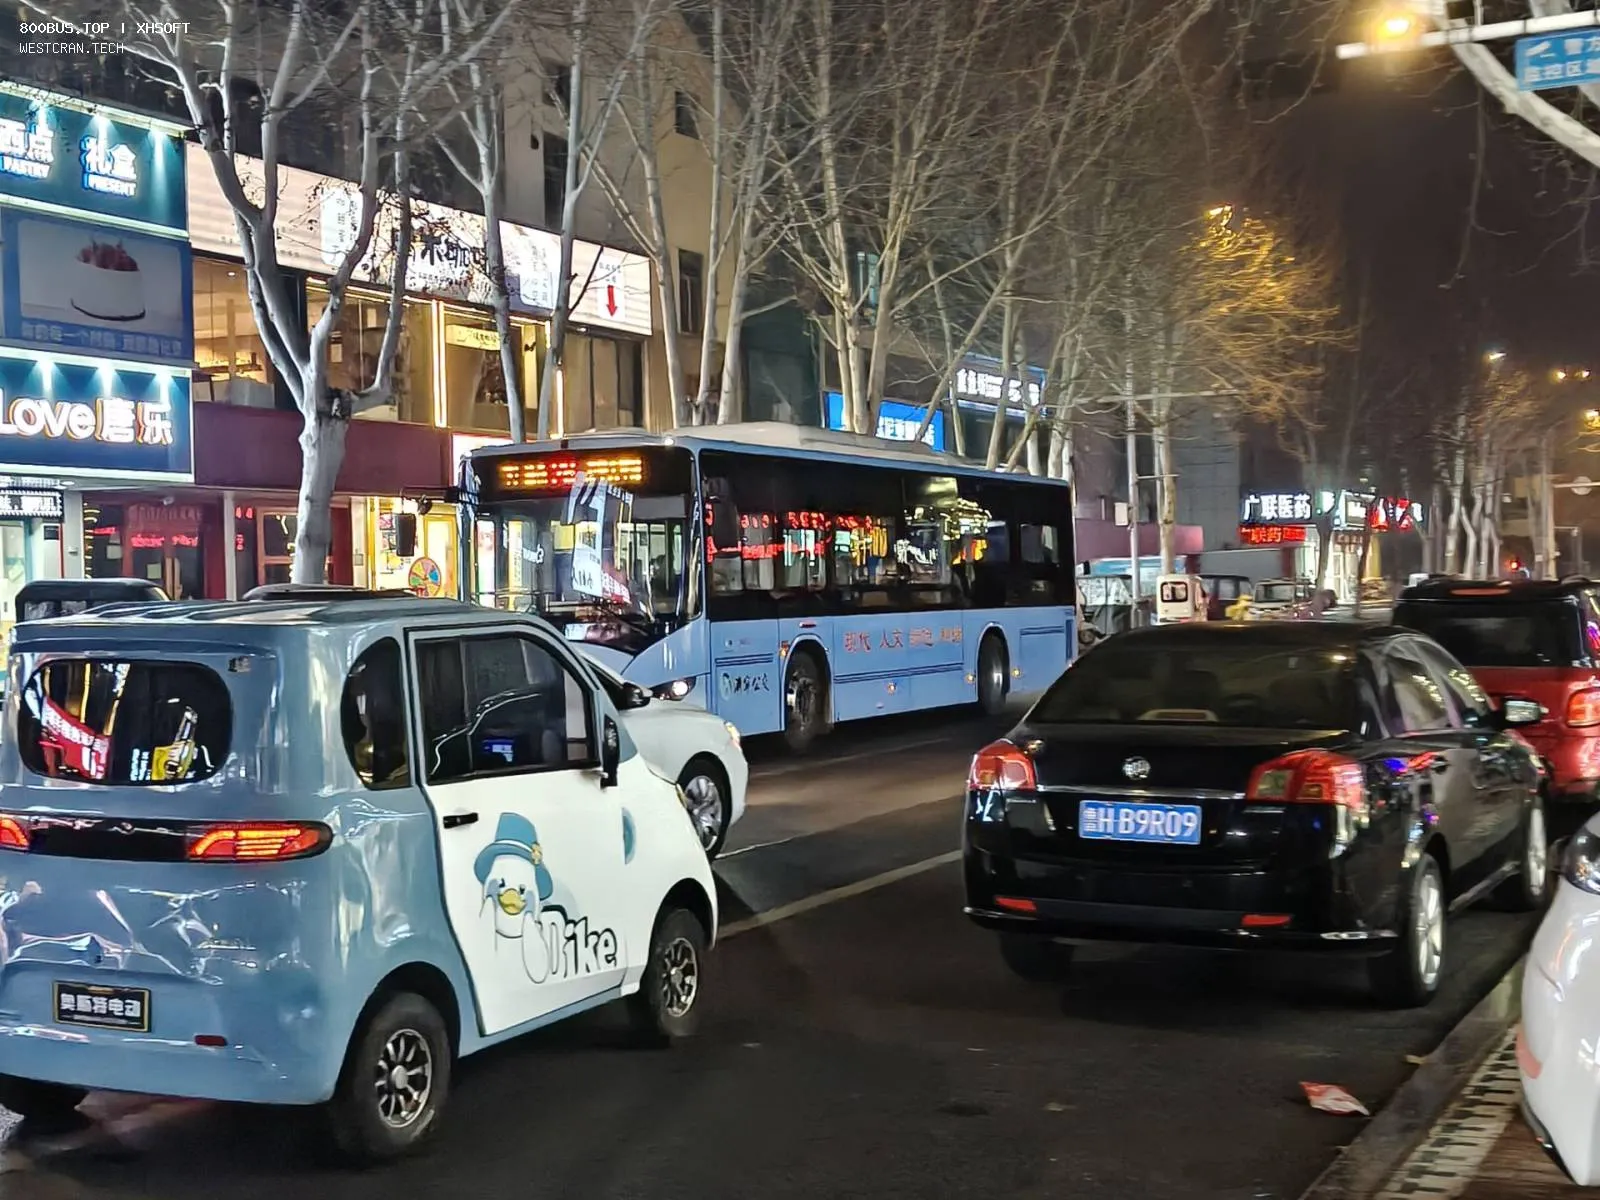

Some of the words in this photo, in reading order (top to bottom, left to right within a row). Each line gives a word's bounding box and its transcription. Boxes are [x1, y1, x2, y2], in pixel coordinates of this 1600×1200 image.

[1243, 493, 1312, 521] 广联医药
[879, 628, 904, 648] 人文
